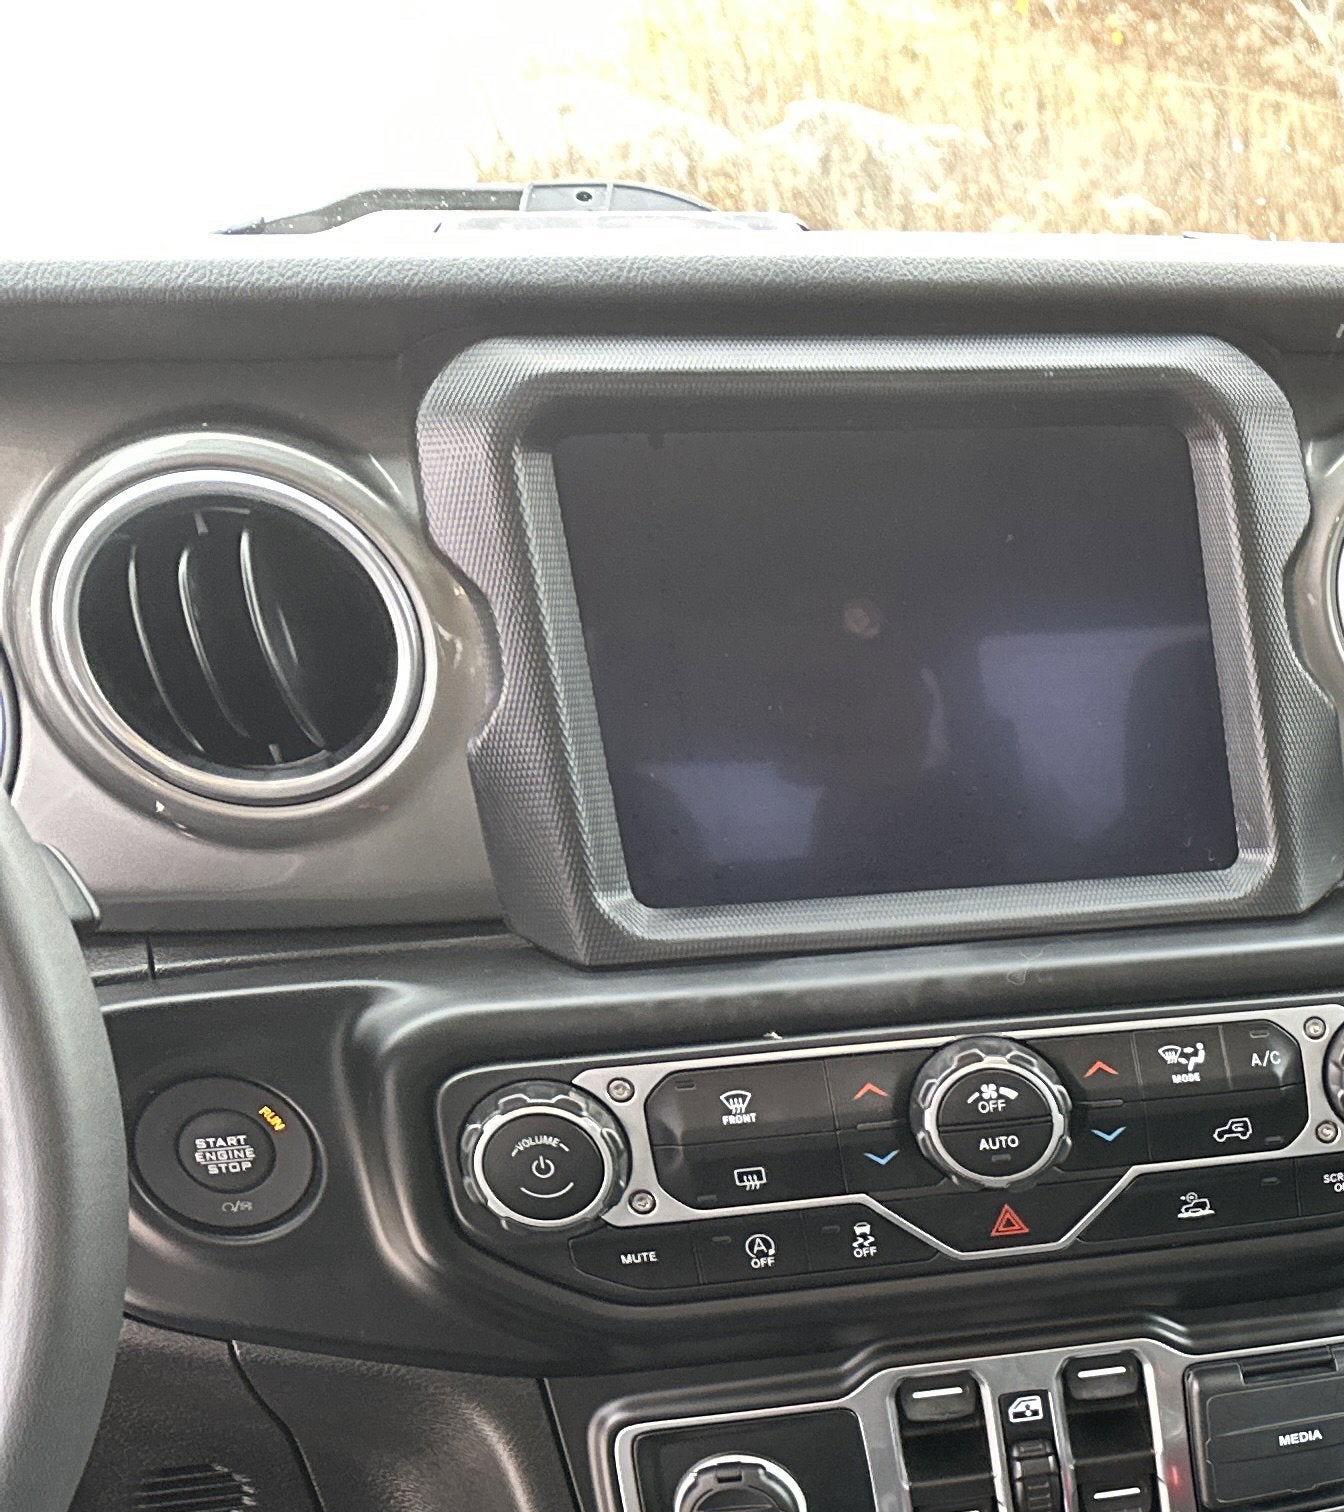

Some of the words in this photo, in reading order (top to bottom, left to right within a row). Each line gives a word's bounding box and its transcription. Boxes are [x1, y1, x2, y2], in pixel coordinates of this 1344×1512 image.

[1251, 1050, 1281, 1067] A/C
[1172, 1072, 1201, 1084] MODE
[978, 1099, 1006, 1114] OFF
[258, 1105, 286, 1131] RUN
[722, 1113, 757, 1126] FRONT
[195, 1134, 247, 1149] START
[515, 1135, 561, 1151] VOLUME
[979, 1135, 1019, 1151] AUTO
[194, 1148, 256, 1163] ENGINE
[208, 1161, 252, 1175] STOP
[620, 1251, 659, 1264] MUTE
[853, 1246, 878, 1258] OFF
[751, 1257, 775, 1269] OFF
[1278, 1429, 1323, 1447] MEDIA
